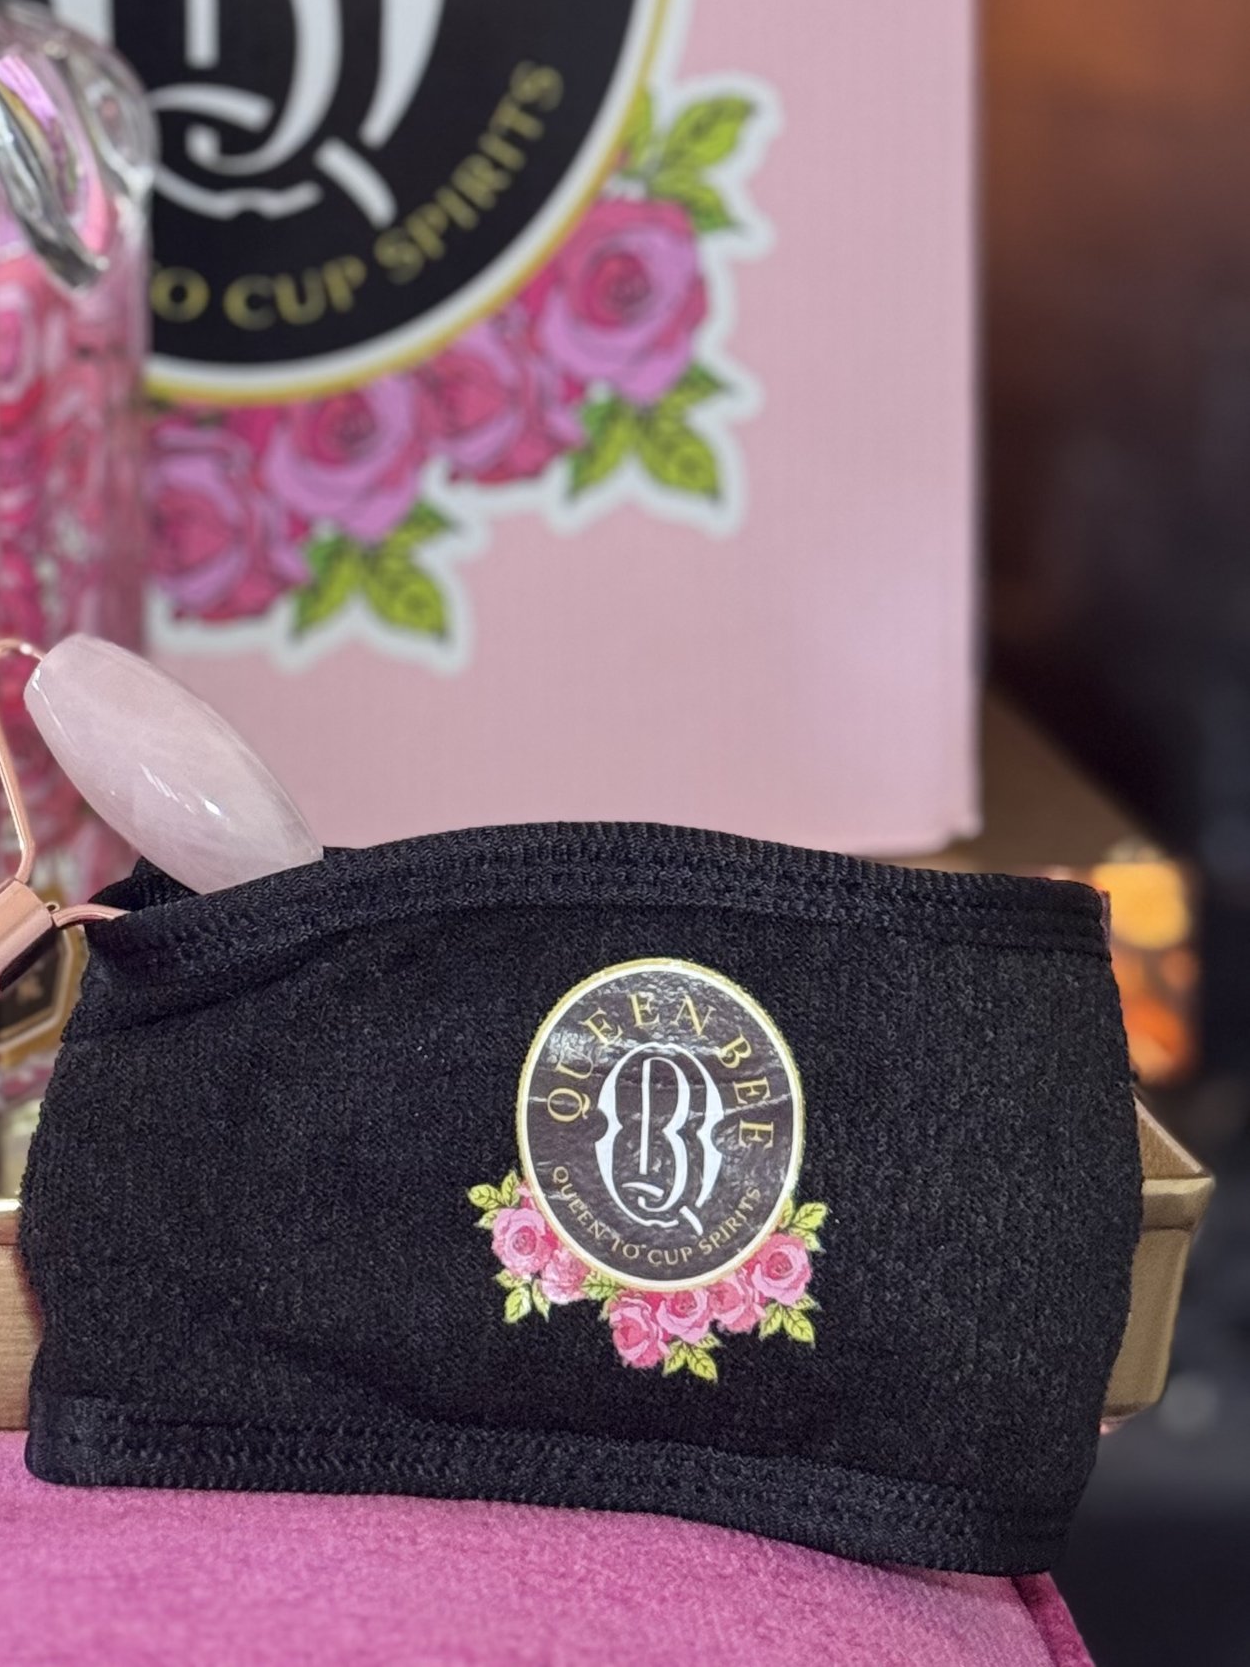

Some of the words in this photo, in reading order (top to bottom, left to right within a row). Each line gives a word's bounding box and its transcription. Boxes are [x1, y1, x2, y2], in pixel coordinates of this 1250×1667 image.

[151, 264, 211, 324] O
[222, 254, 368, 332] CUP
[373, 59, 565, 285] SPIRITS
[552, 1166, 611, 1240] QUEEN
[609, 1234, 641, 1260] TO
[647, 1245, 693, 1266] CUP
[698, 1187, 762, 1256] SPIRITS
